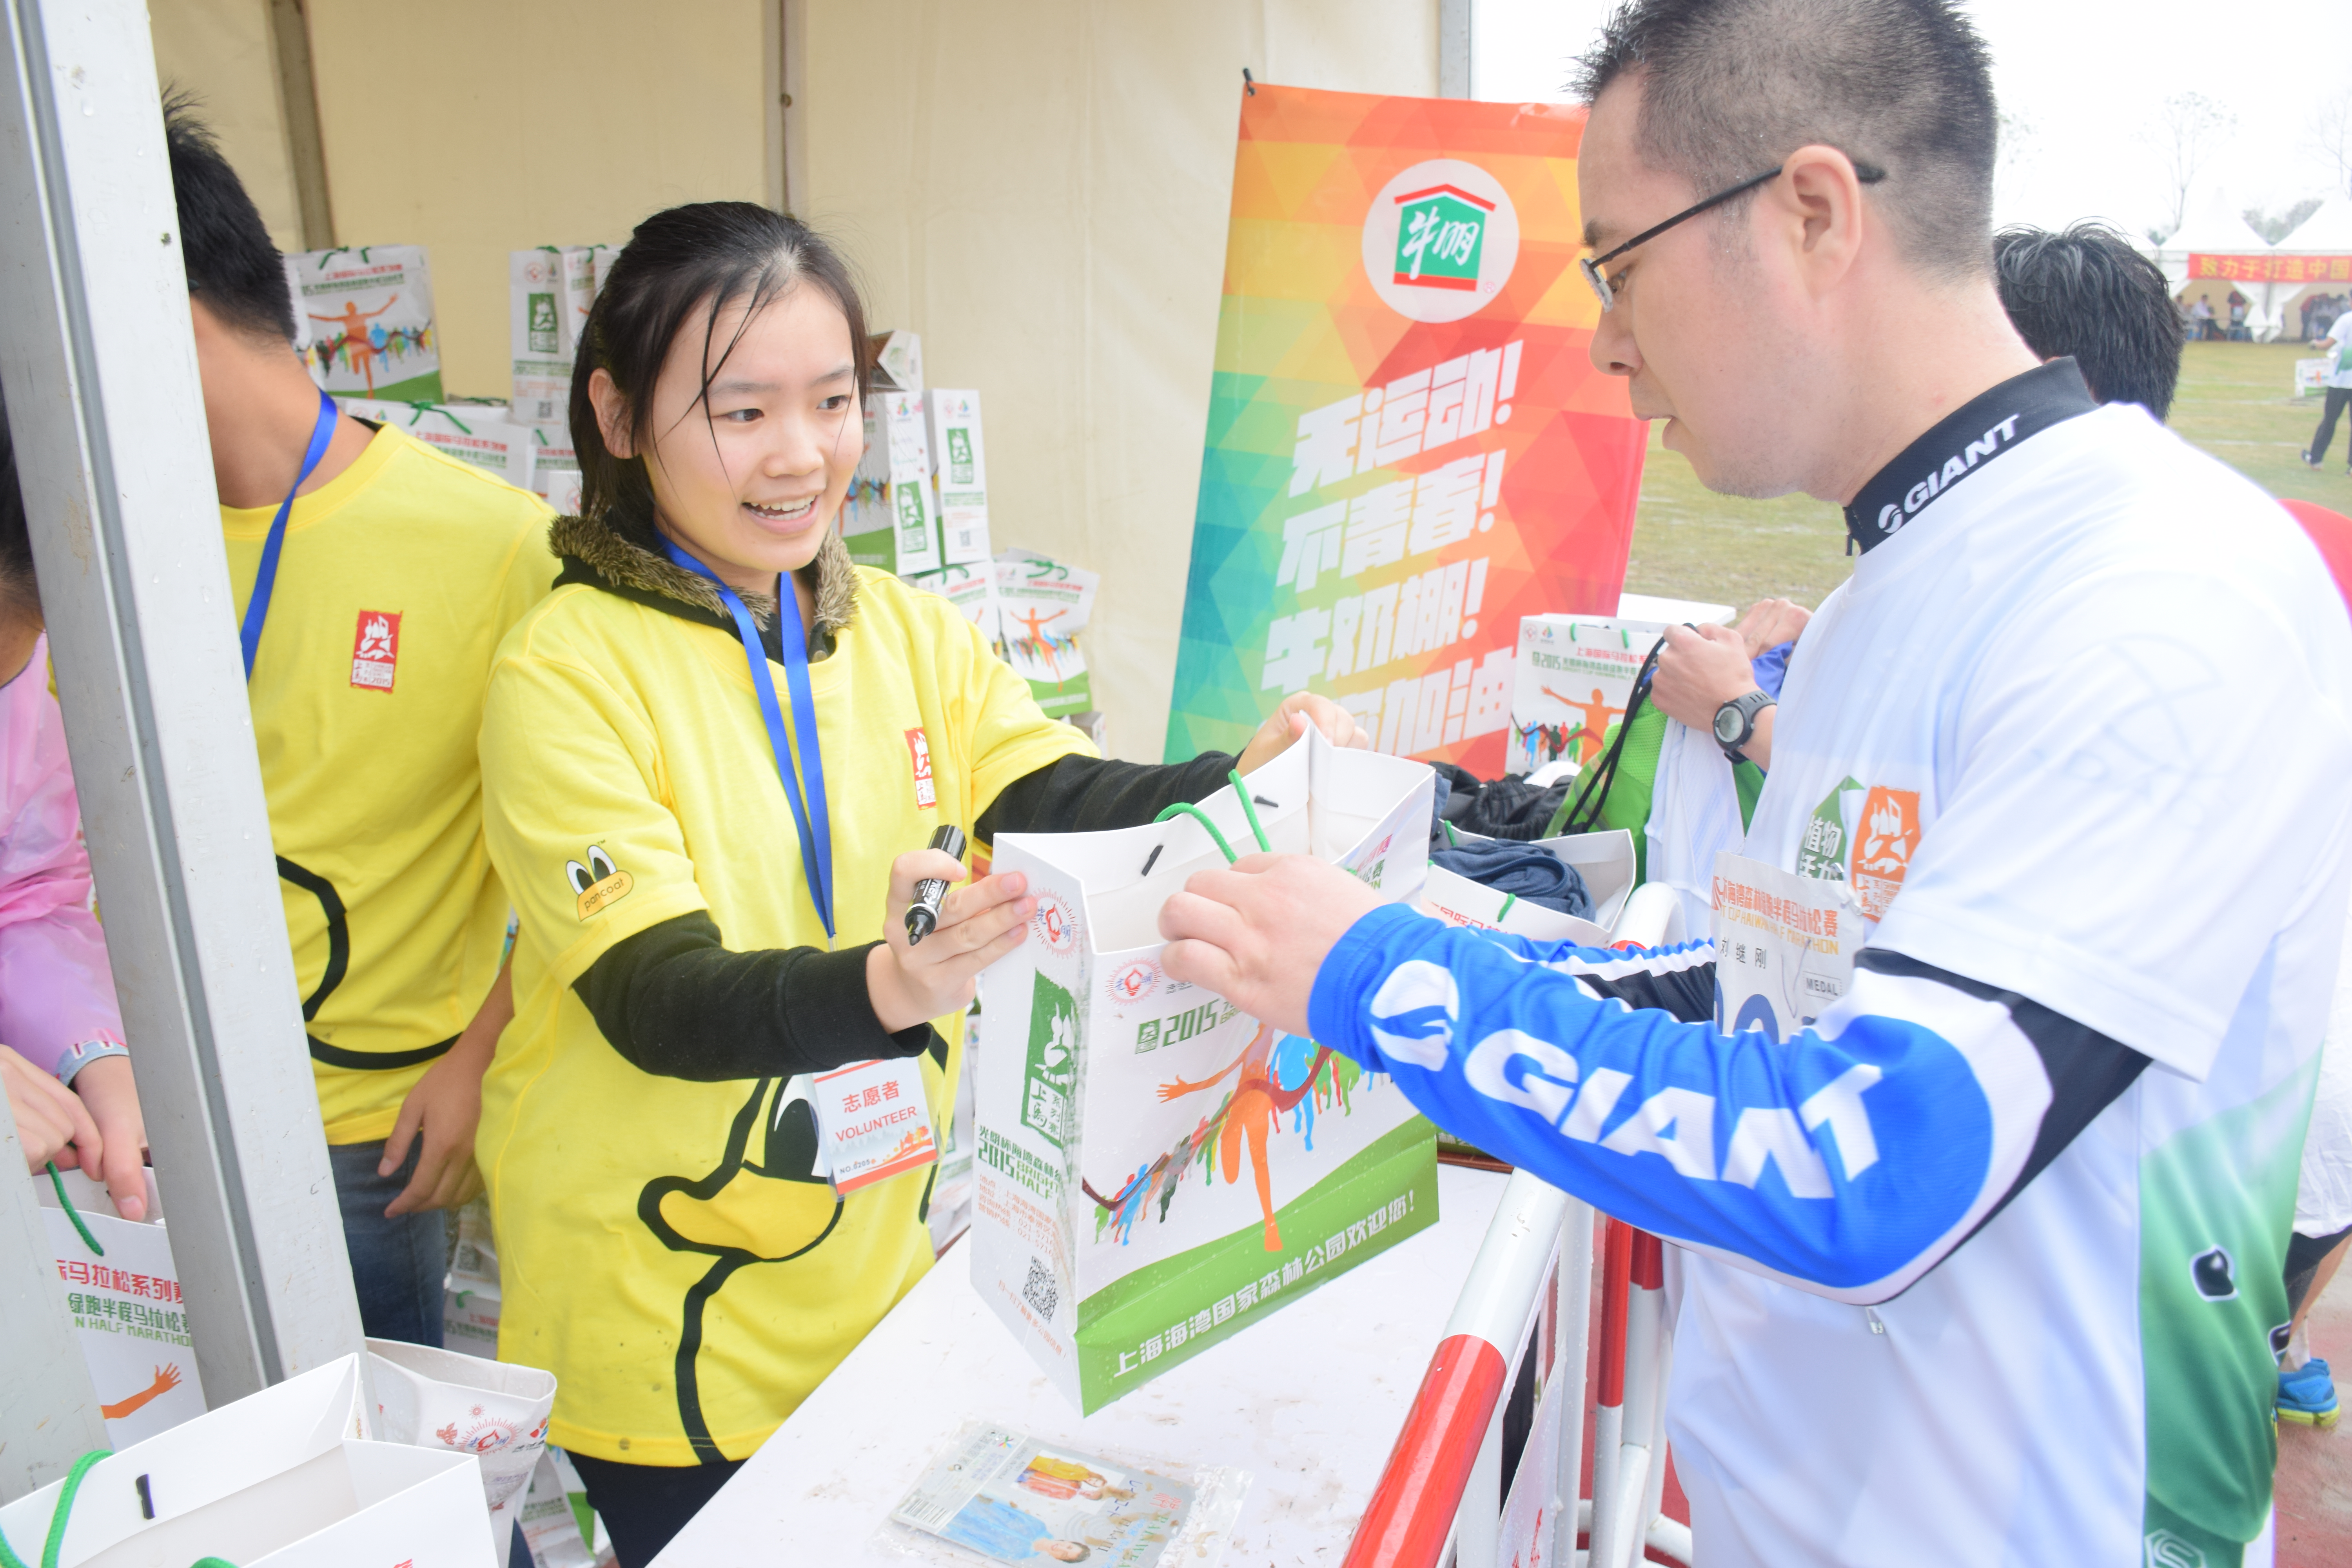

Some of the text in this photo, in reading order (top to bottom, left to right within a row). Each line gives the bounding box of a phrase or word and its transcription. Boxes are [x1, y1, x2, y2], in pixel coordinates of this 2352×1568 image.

[2200, 257, 2350, 280] 致力于打造中国
[1904, 412, 2021, 514] GIANT
[1804, 815, 1842, 858] 植物
[583, 878, 625, 911] pancoat
[1806, 978, 1838, 996] MEDAL
[1162, 998, 1220, 1047] 2015
[842, 1080, 900, 1114] 志愿者
[1465, 1028, 1883, 1200] GIANT
[836, 1106, 918, 1142] VOLUNTEER
[978, 1137, 1015, 1178] 2015
[1016, 1171, 1053, 1200] HALF
[1113, 1189, 1415, 1378] 上海海湾国家森林公园欢迎您!
[89, 1318, 123, 1334] HALF
